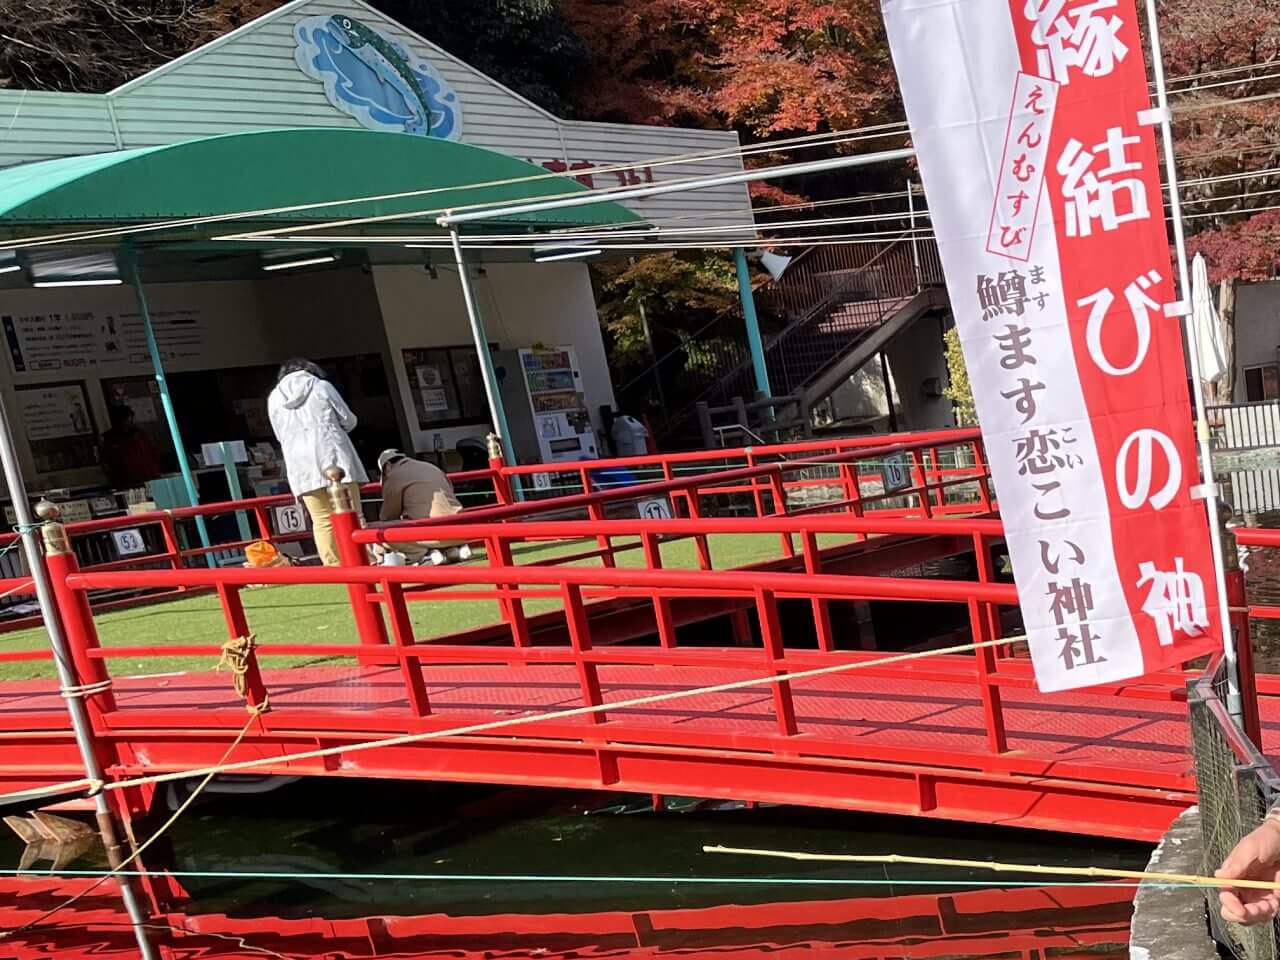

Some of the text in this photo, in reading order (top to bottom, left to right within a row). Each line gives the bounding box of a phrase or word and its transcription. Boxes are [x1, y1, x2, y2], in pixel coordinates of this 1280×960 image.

[999, 85, 1045, 248] えんむすび
[1028, 265, 1050, 312] ます
[976, 269, 1108, 671] 鱒ます恋こい神社
[1061, 426, 1084, 470] こい
[889, 461, 901, 482] 16
[284, 511, 299, 528] 15
[121, 534, 138, 550] 53
